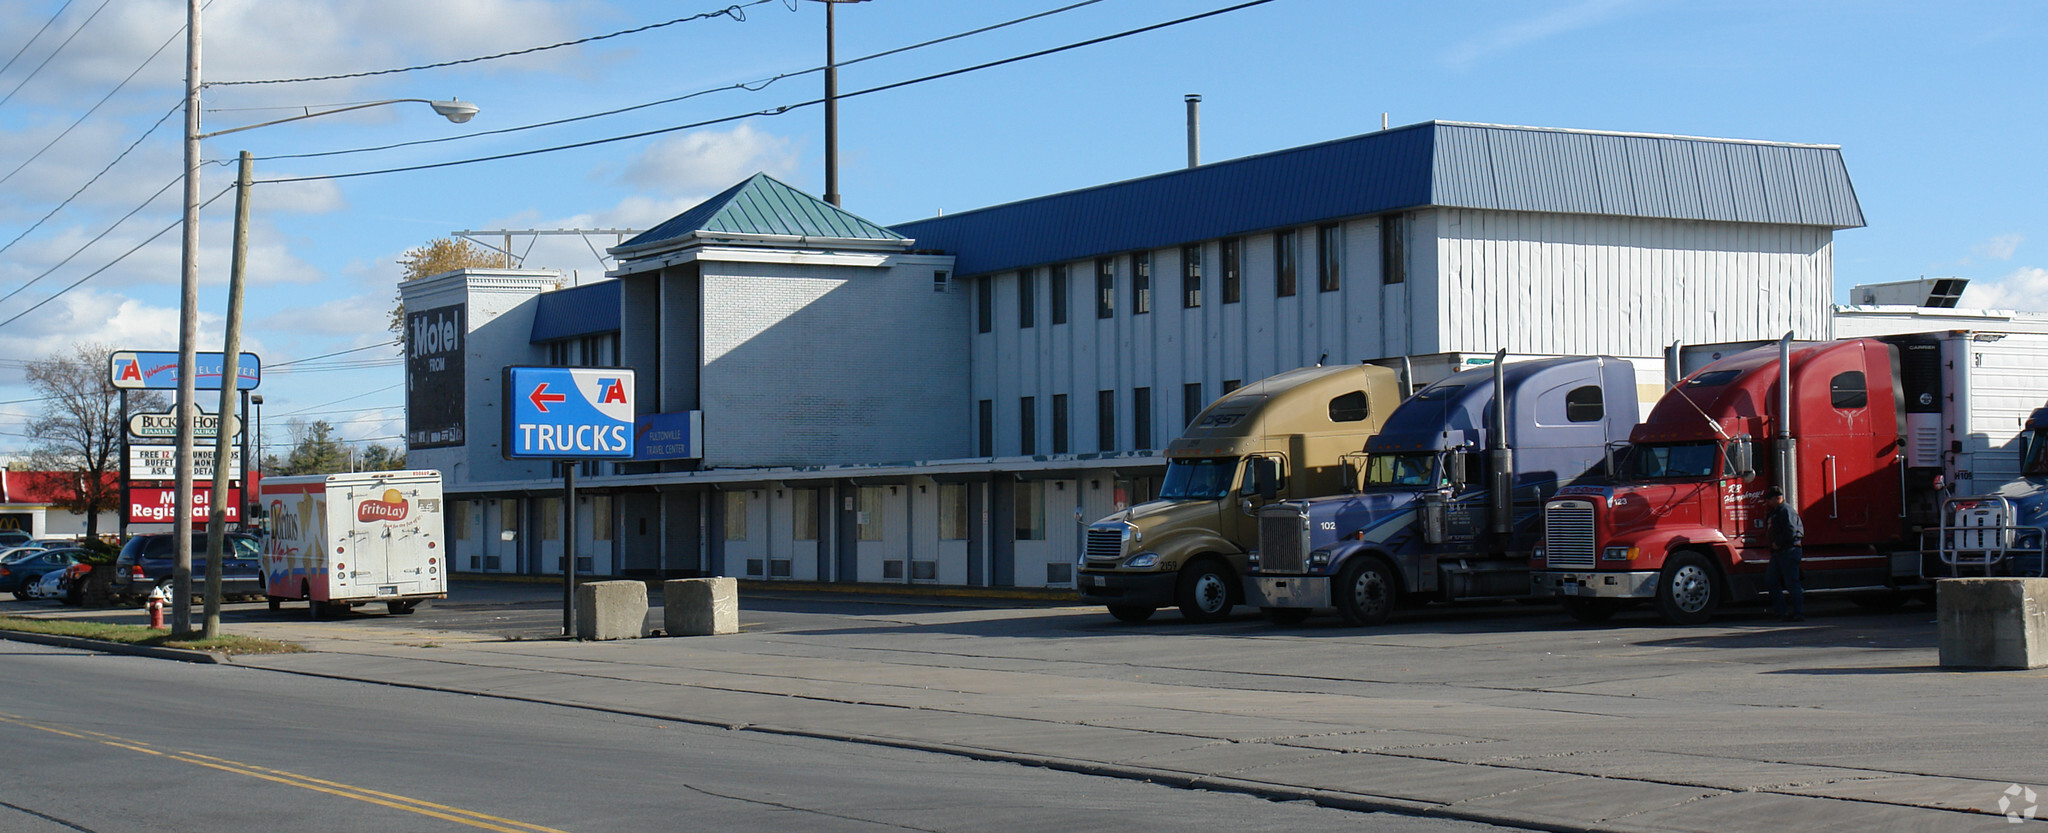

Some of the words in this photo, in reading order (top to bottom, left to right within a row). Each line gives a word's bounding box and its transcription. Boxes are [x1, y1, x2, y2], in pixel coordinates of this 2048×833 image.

[414, 310, 459, 359] Motel
[114, 358, 142, 381] TA
[429, 357, 445, 372] FROM
[597, 377, 628, 404] TA
[519, 423, 628, 452] TRUCKS
[649, 429, 681, 441] FULTONVILLE
[140, 450, 159, 459] FREE
[162, 450, 170, 458] 12
[192, 451, 216, 459] UNDE
[646, 445, 664, 455] TRAVEL
[665, 443, 685, 454] CENTER
[145, 459, 174, 467] BUFFET
[151, 467, 167, 475] ASK
[193, 467, 214, 475] DETA
[159, 490, 209, 504] Mel
[1320, 521, 1336, 530] 102
[1160, 561, 1177, 571] 2159
